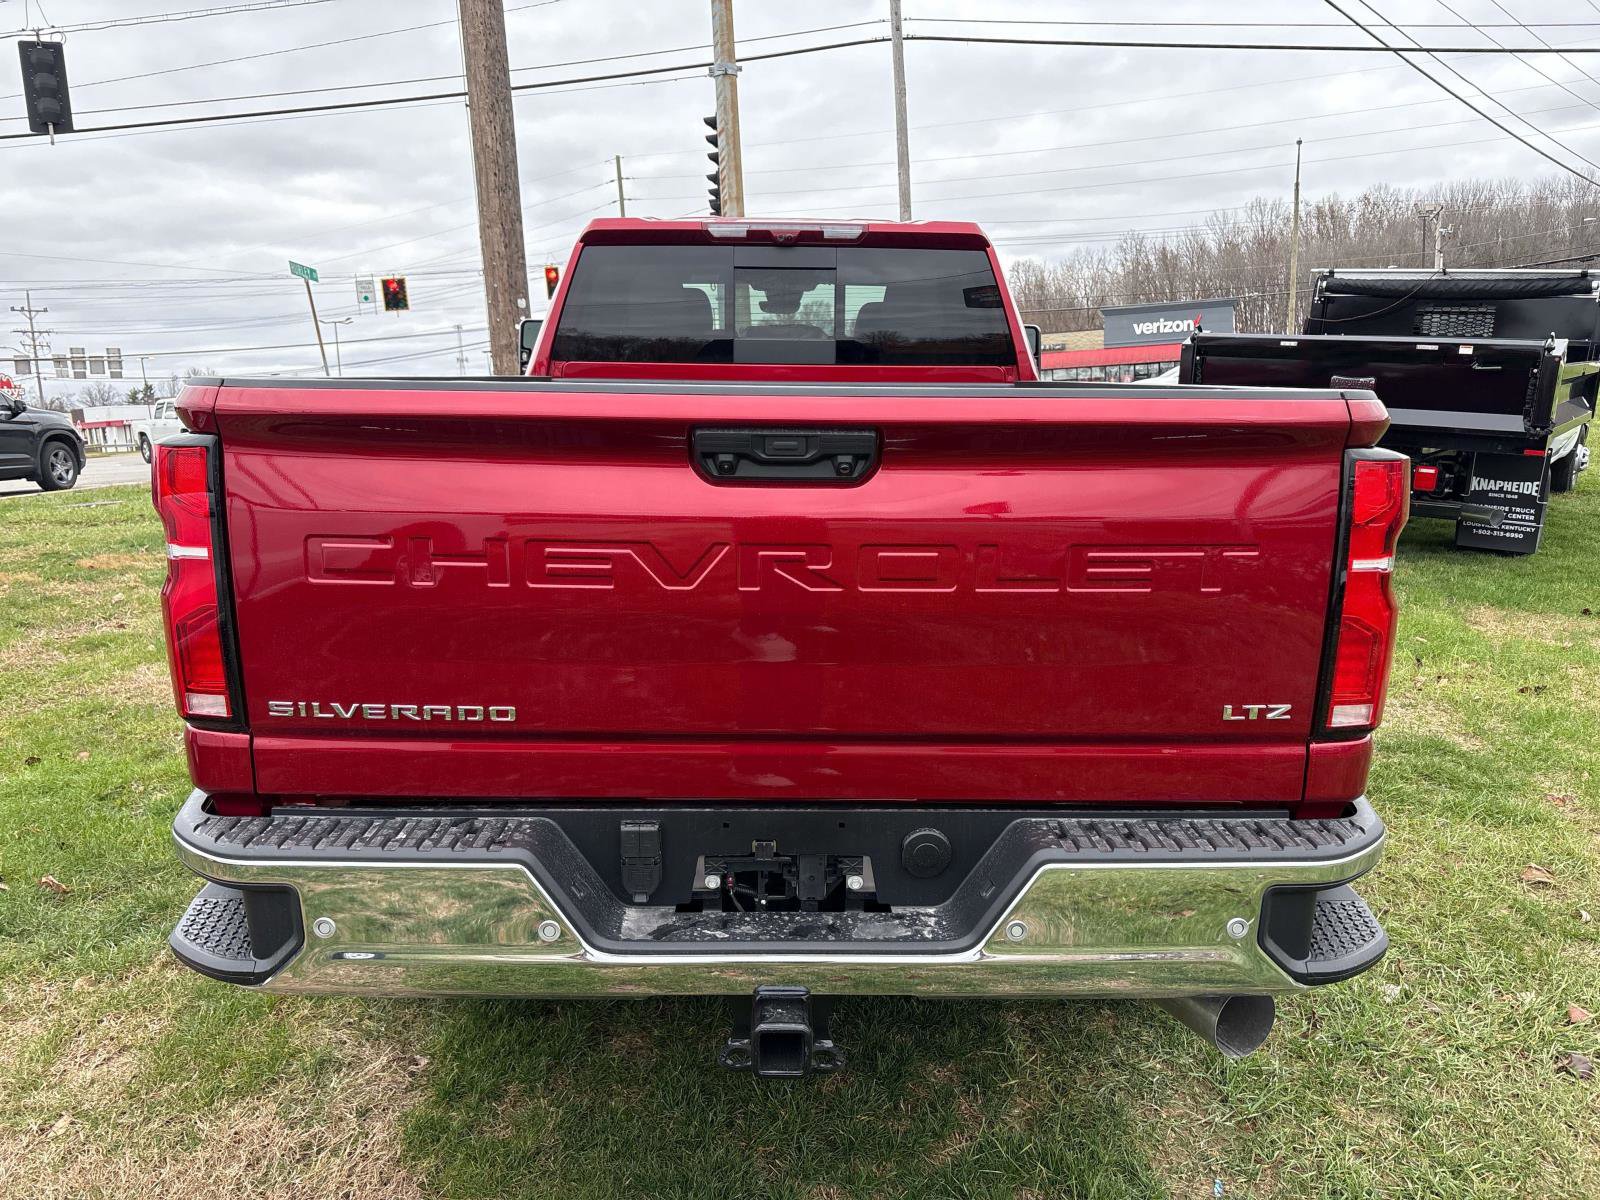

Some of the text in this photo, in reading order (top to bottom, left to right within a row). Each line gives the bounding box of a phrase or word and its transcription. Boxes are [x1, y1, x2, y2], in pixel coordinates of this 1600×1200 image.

[1132, 317, 1195, 335] verizon
[1471, 476, 1540, 496] KNAPHEIDE
[1507, 513, 1535, 521] CENTER
[1511, 506, 1536, 514] TRUCK
[1501, 524, 1536, 532] KENTUCKY
[304, 534, 1260, 592] CHEVROLET
[267, 700, 517, 722] SILVERADO
[1222, 704, 1292, 720] LTZ
